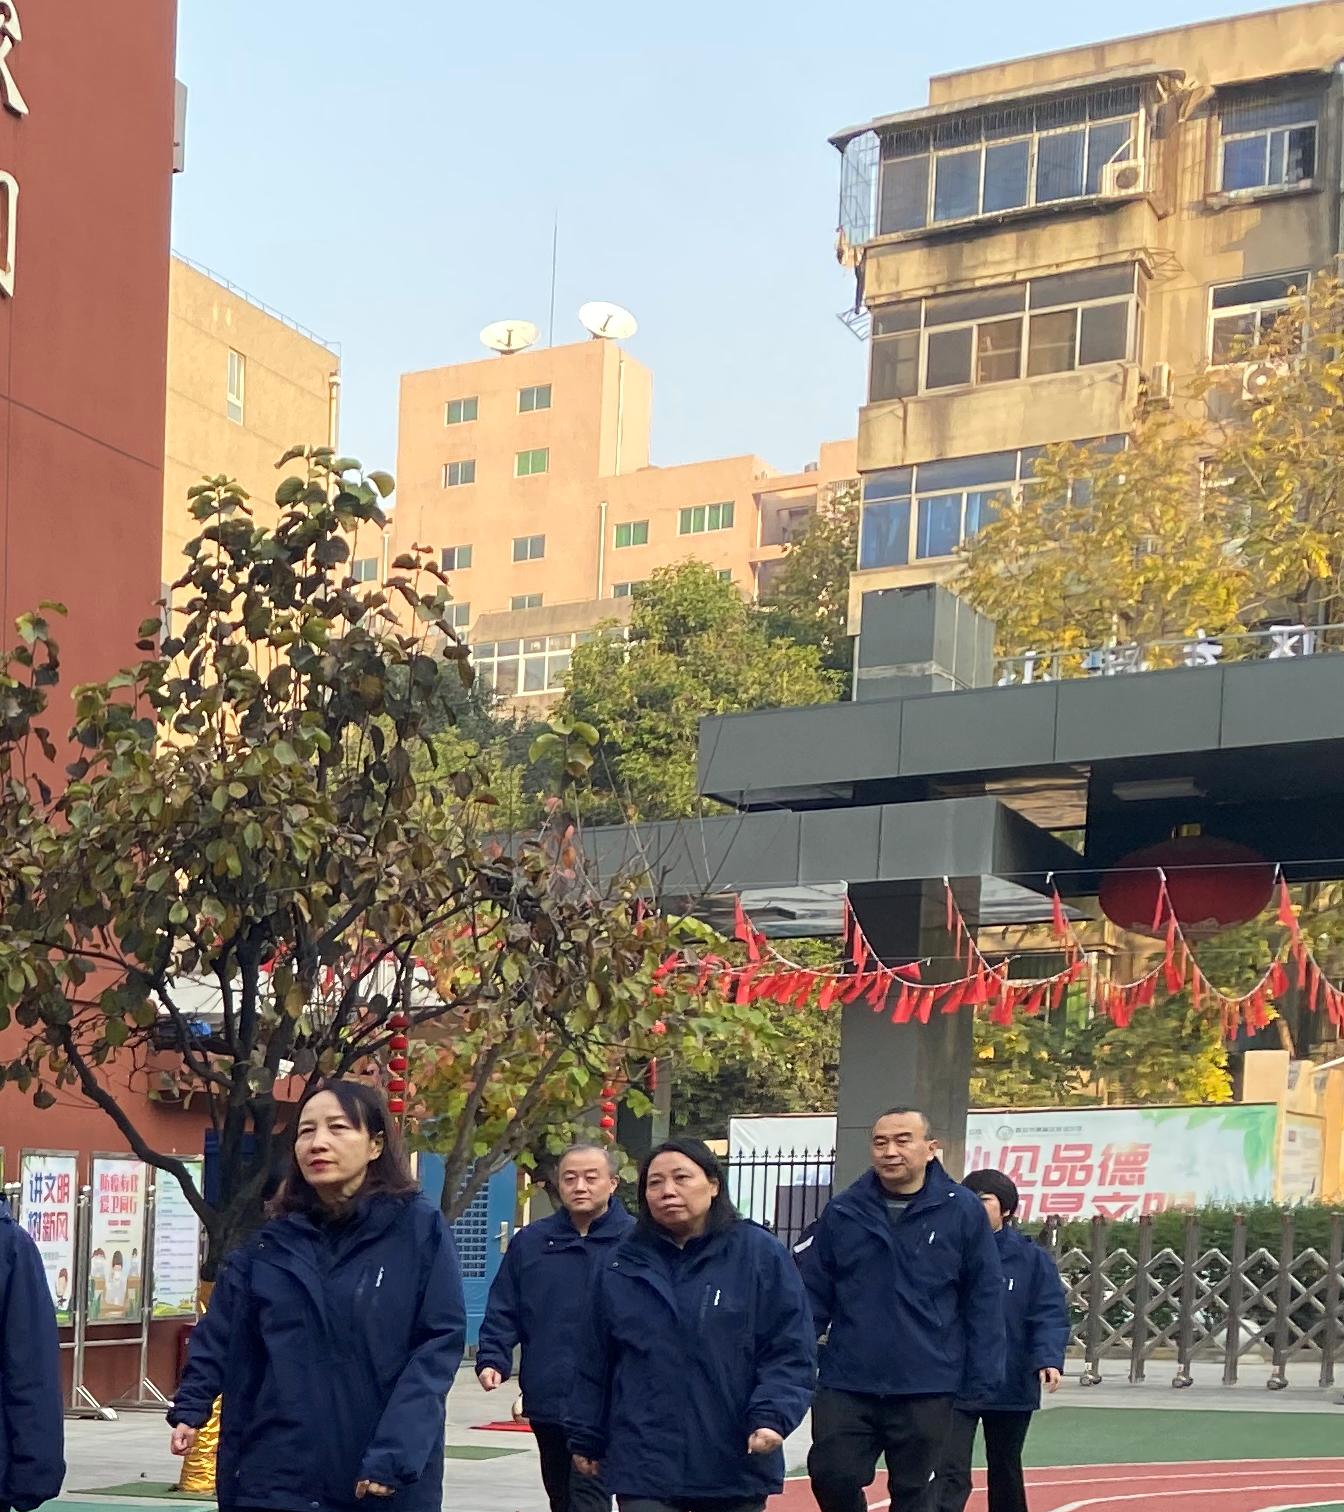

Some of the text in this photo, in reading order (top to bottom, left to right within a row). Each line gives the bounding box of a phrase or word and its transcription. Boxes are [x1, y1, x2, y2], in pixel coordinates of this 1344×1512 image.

[29, 1172, 70, 1204] 讲文明
[28, 1211, 69, 1242] 树新风
